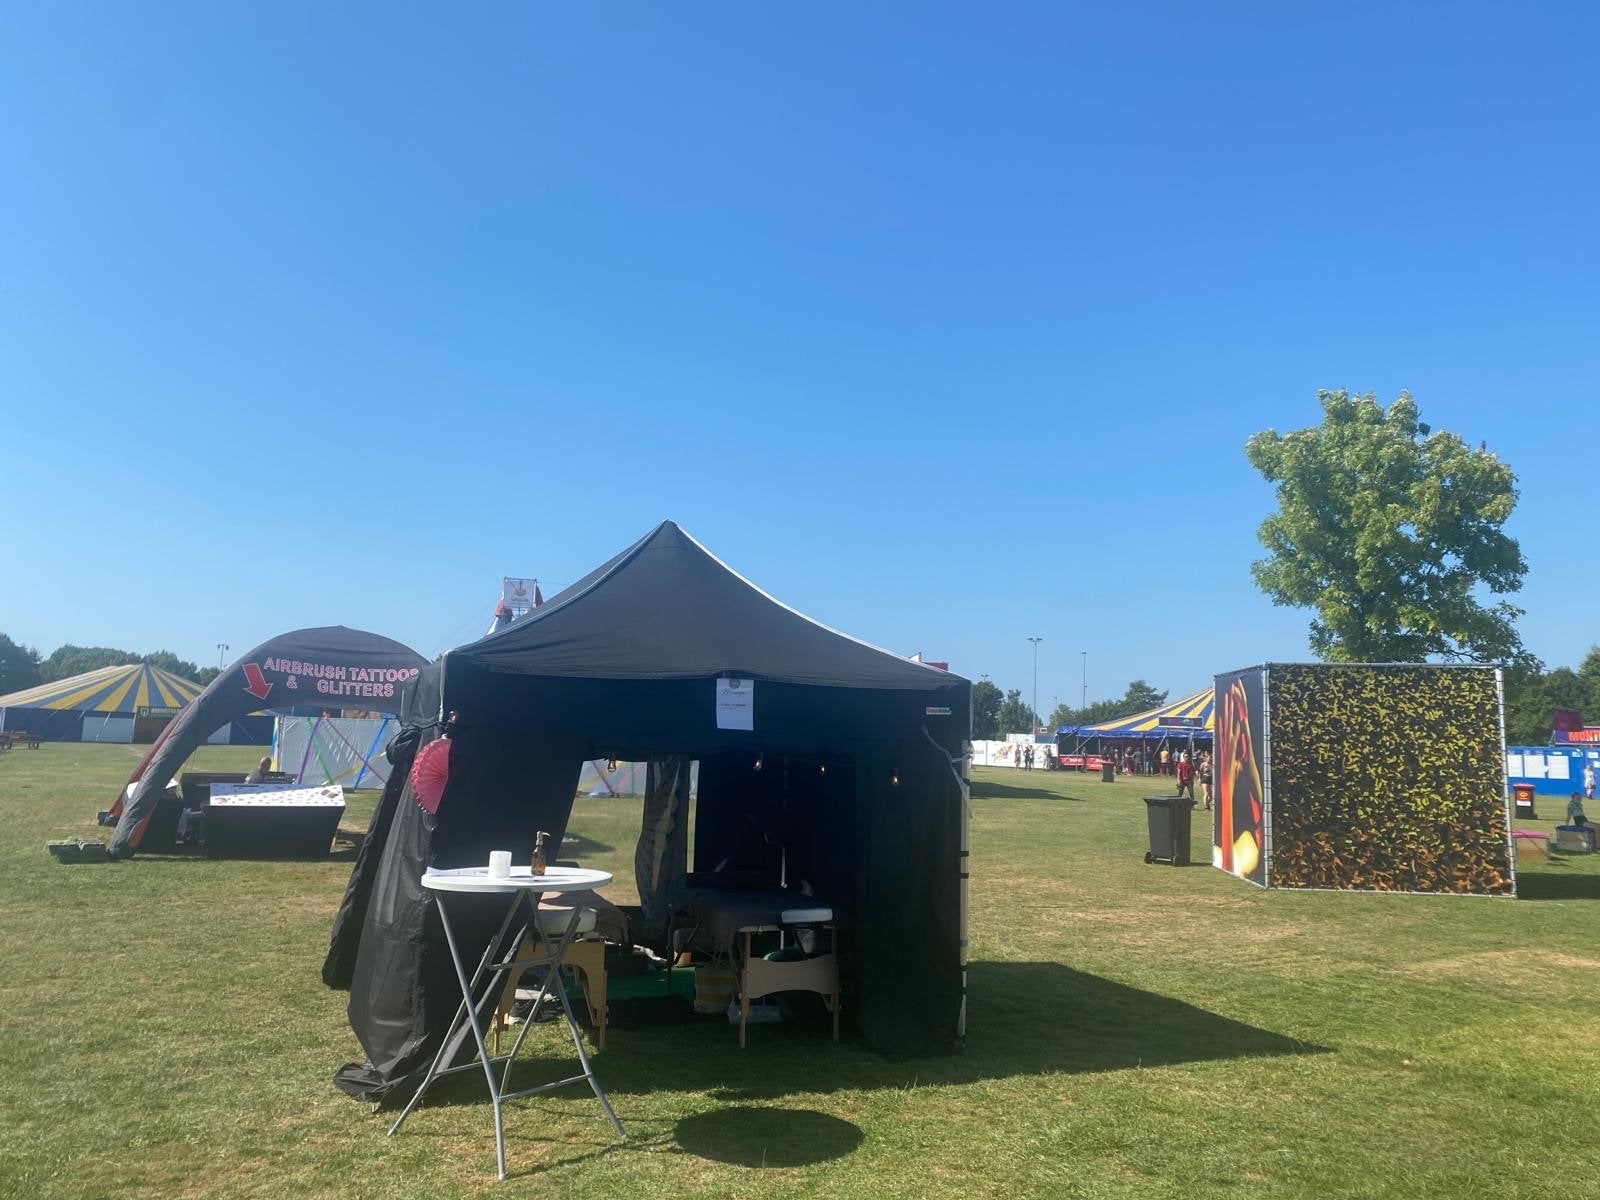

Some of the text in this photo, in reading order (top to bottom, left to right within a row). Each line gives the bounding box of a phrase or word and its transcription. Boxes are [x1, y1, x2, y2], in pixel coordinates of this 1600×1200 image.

[264, 656, 346, 680] AIRBRUSH
[286, 674, 394, 697] & GLITTERS
[1567, 730, 1600, 742] MUNT
